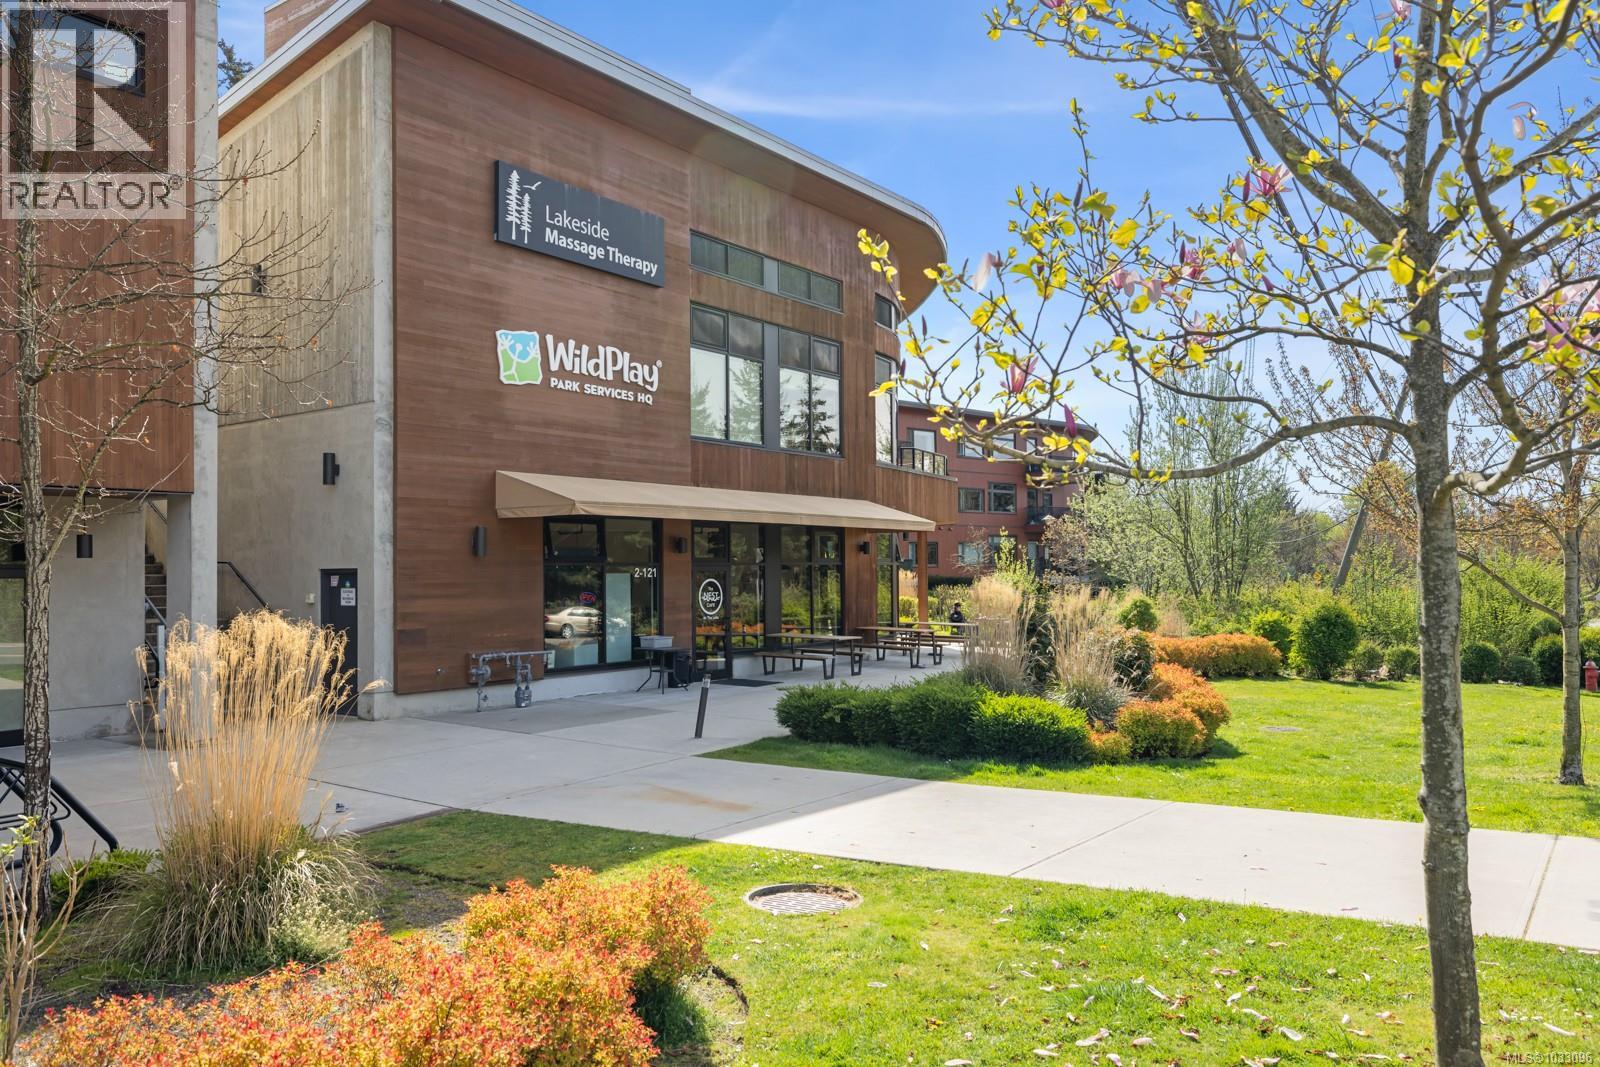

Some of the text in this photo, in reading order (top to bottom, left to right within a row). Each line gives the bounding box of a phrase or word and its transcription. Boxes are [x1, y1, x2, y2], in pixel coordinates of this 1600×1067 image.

[545, 205, 610, 241] Lakeside
[545, 227, 658, 277] Massage Therapy
[550, 377, 653, 405] PARK SERVICES HQ
[634, 567, 657, 578] 2-121
